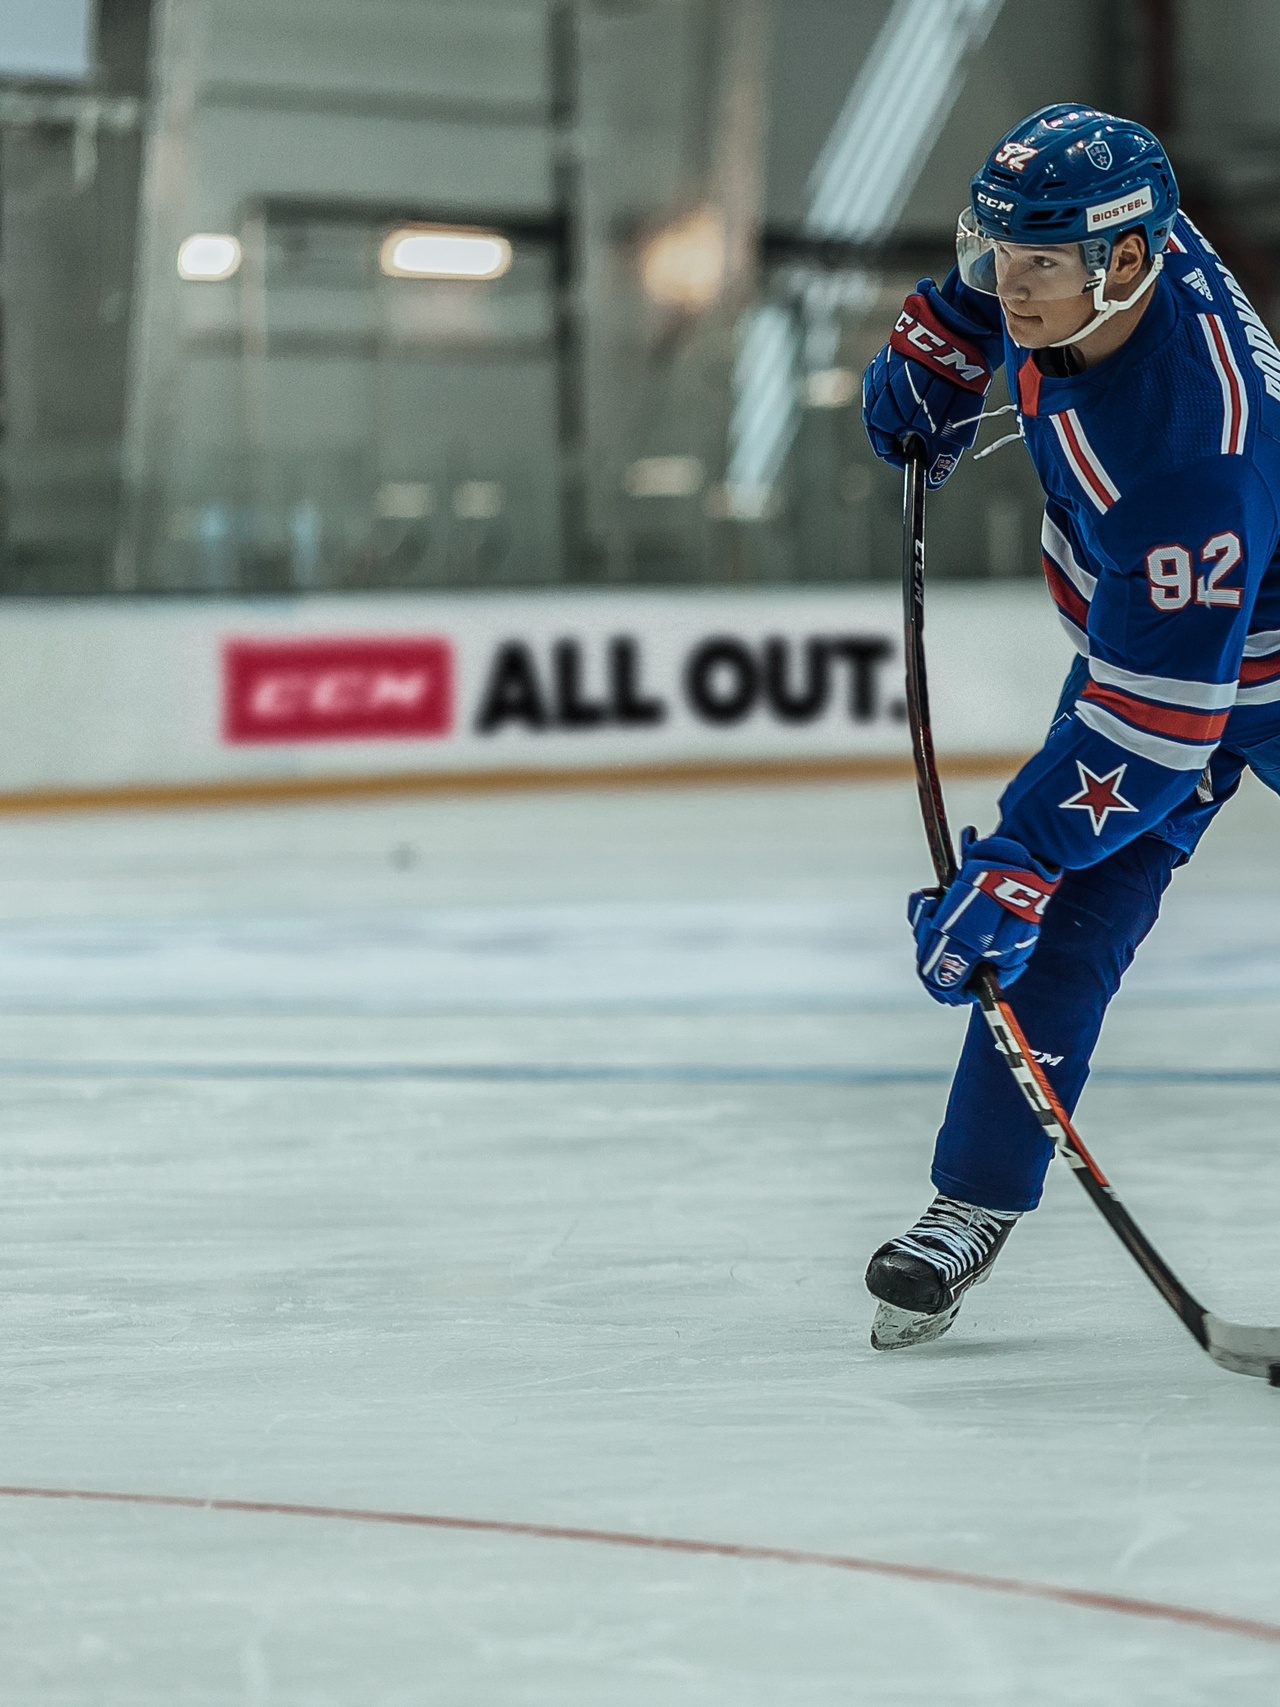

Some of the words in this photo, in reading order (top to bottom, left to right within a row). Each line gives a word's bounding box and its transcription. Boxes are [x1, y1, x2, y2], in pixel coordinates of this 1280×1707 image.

[994, 142, 1039, 172] 92
[977, 191, 1015, 212] CCM
[1092, 198, 1148, 224] BIOSTEEL
[894, 310, 985, 381] CCM
[1146, 530, 1243, 612] 92
[475, 637, 667, 736] ALL
[684, 635, 907, 726] OUT.
